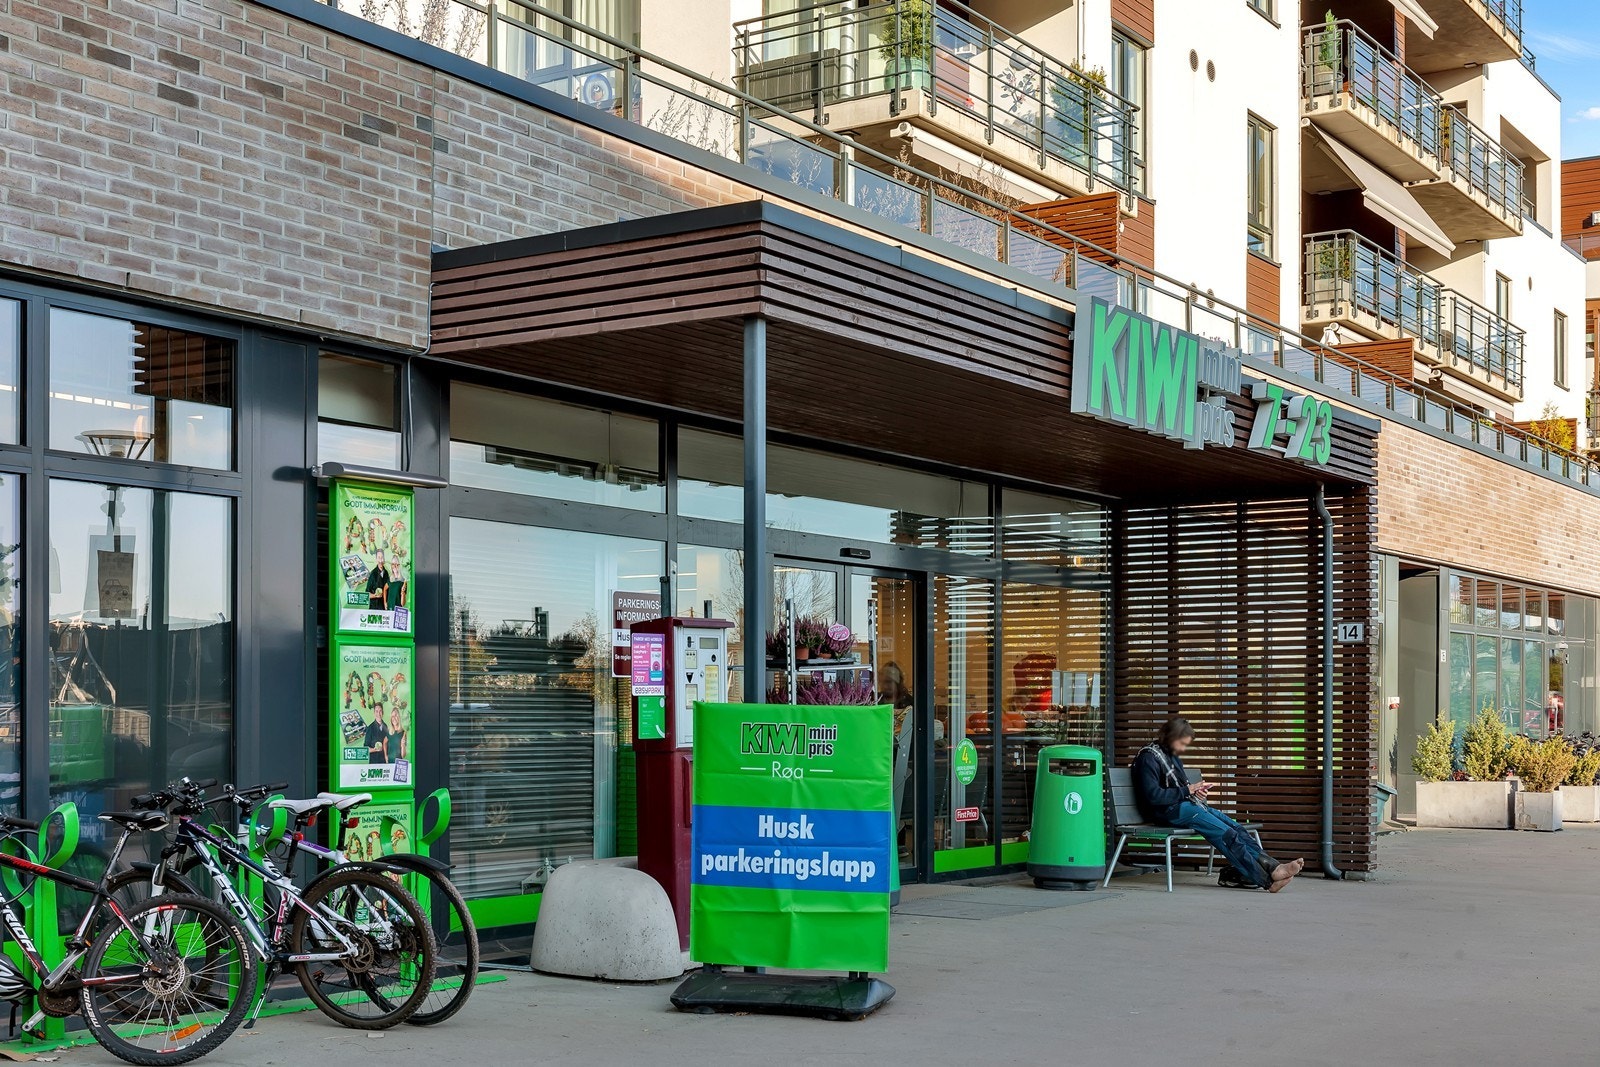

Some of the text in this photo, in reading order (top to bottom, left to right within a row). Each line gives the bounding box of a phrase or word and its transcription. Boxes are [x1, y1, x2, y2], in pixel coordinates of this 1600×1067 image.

[1084, 295, 1200, 444] KIWI
[1202, 340, 1242, 396] mini
[1199, 396, 1235, 448] pris
[1254, 382, 1333, 465] 7-23
[618, 598, 661, 610] PARKERINGS-
[616, 631, 630, 641] Hus
[1342, 625, 1358, 640] 14
[362, 656, 408, 665] IMMUNFORSVAR
[741, 723, 838, 755] KIWI mini
[808, 740, 835, 759] pris
[771, 761, 804, 779] Røa
[758, 814, 814, 840] Husk
[701, 848, 876, 883] parkeringslapp
